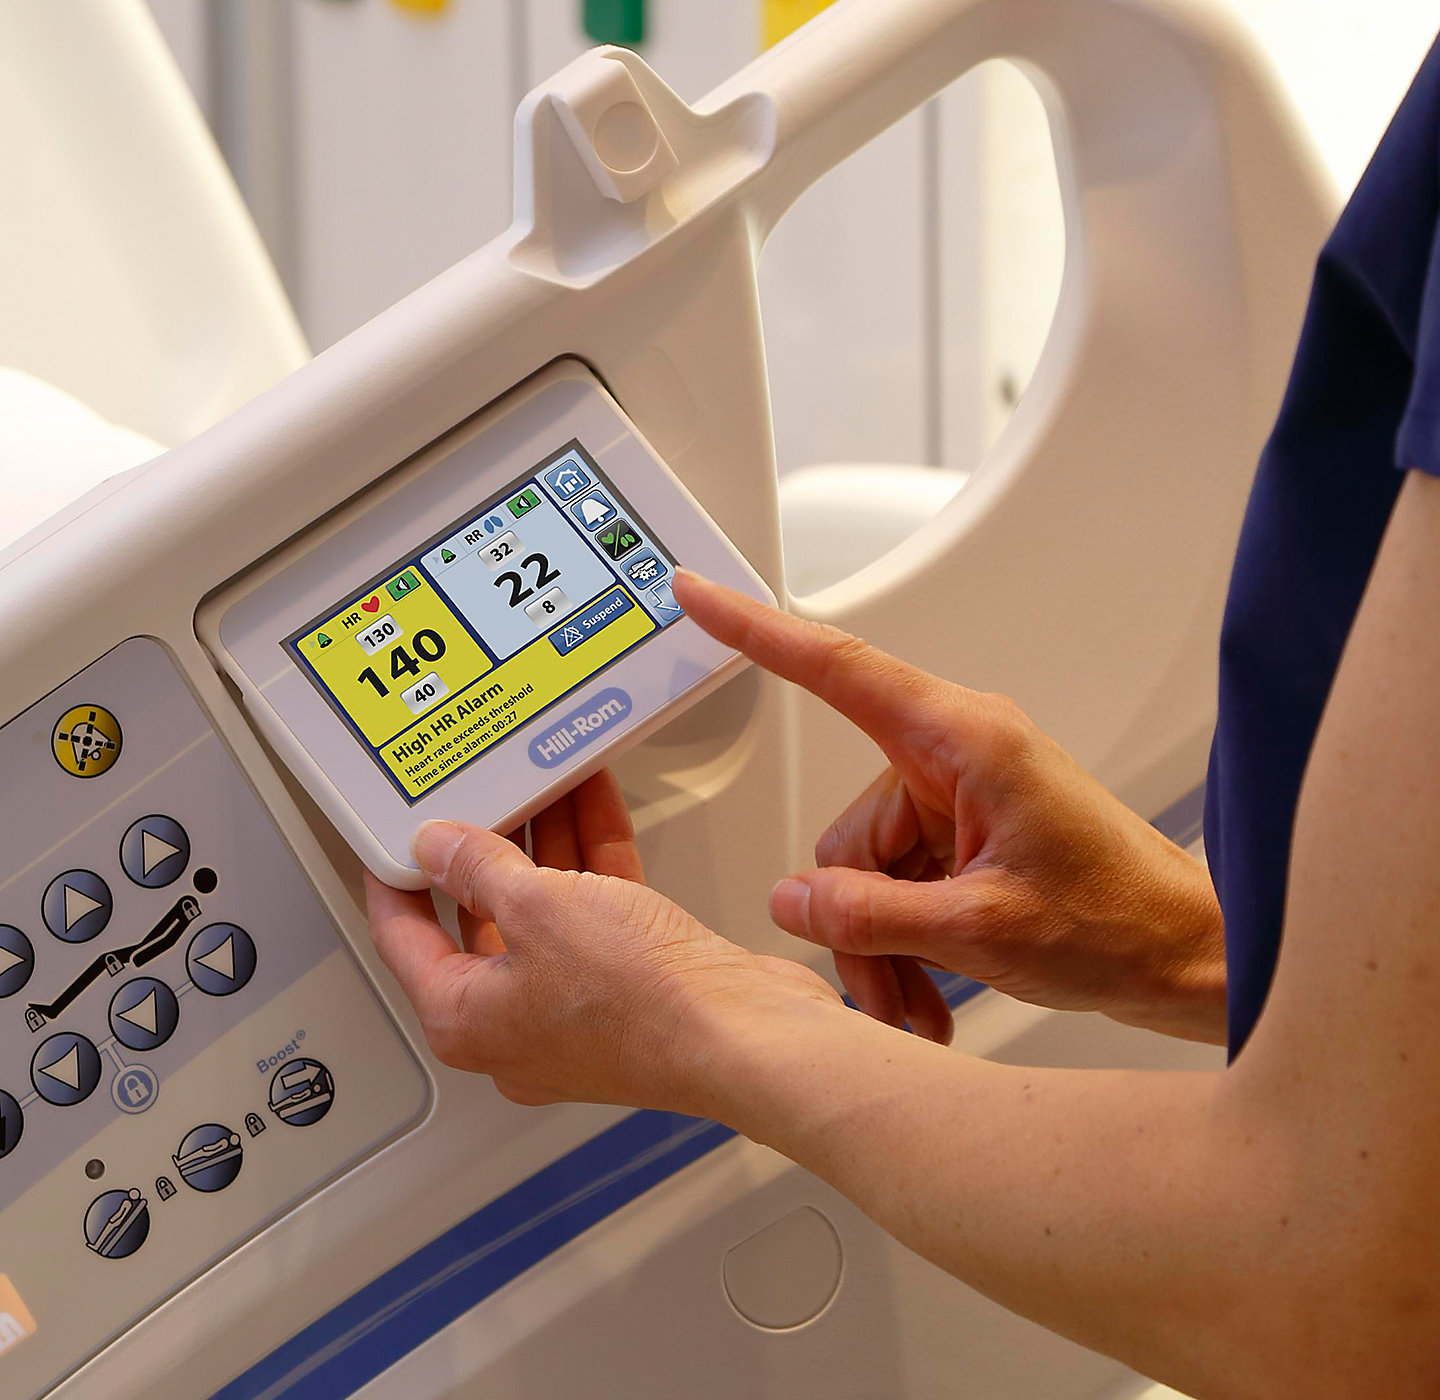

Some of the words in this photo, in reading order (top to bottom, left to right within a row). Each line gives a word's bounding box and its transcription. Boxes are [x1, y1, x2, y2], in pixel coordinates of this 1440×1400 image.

[464, 529, 484, 545] RR
[489, 542, 513, 562] 32
[493, 552, 561, 608] 22
[341, 612, 362, 629] HR
[541, 600, 556, 614] 8
[582, 597, 624, 630] Suspend
[363, 622, 395, 647] 130
[357, 629, 446, 697] 140
[415, 683, 436, 702] 40
[391, 732, 433, 763] High
[429, 713, 458, 736] HR
[455, 683, 504, 720] Alarm
[404, 755, 434, 777] Heart
[433, 741, 454, 759] rate
[453, 715, 490, 745] exceeds
[488, 683, 534, 719] threshold
[536, 698, 624, 761] Hill-Rom
[412, 768, 440, 788] Time
[438, 751, 464, 772] since
[463, 730, 494, 754] alarm:
[491, 710, 518, 733] 00:27
